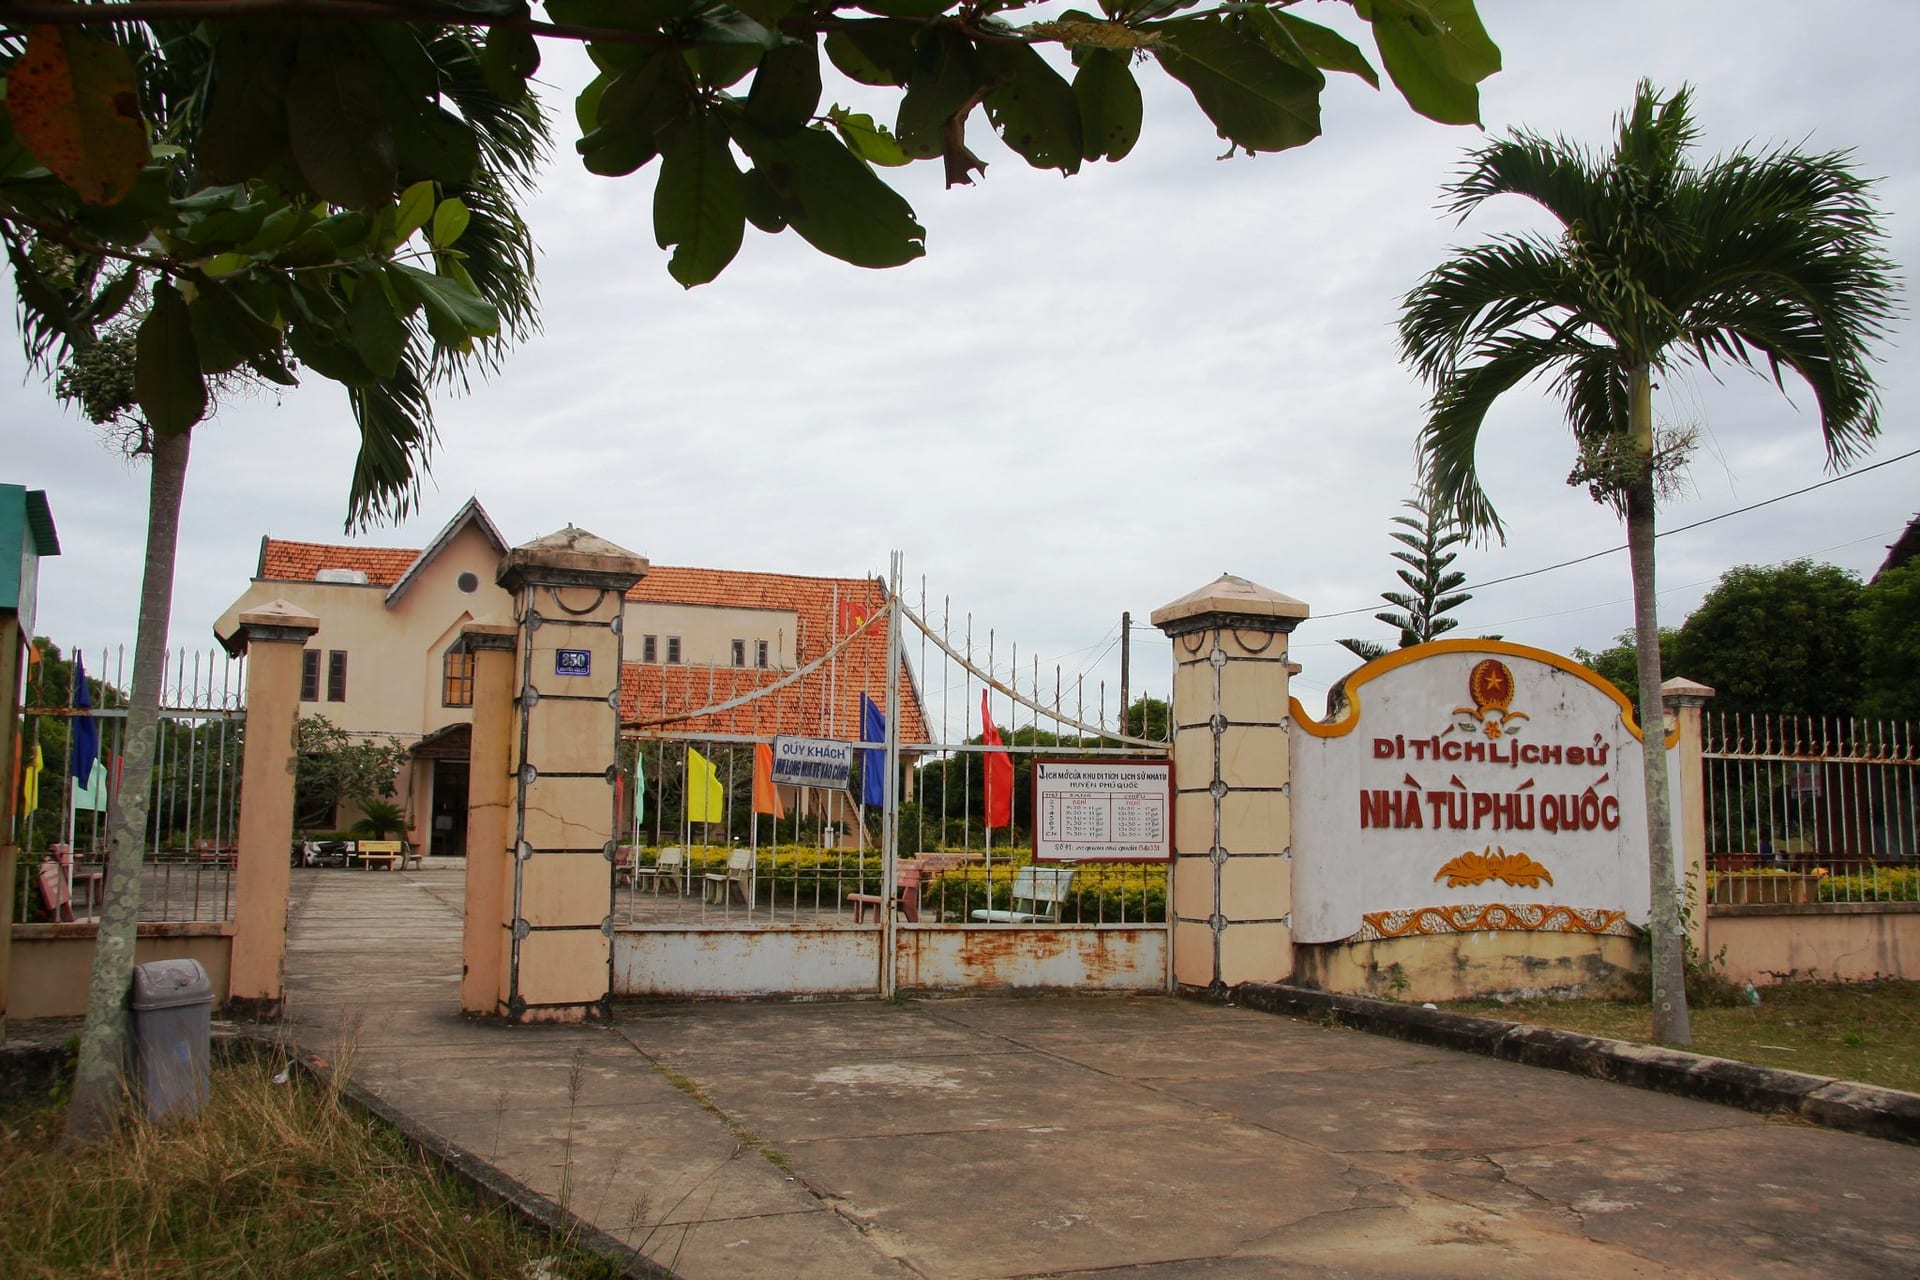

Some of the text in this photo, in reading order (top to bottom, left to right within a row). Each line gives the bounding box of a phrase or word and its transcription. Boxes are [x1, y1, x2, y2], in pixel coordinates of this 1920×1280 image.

[1409, 724, 1486, 762] TÍCH
[1489, 738, 1563, 768] LỊCH
[1565, 733, 1610, 766] SỬ
[1360, 772, 1620, 834] NHÀ TÙ PHÚ QUỐC
